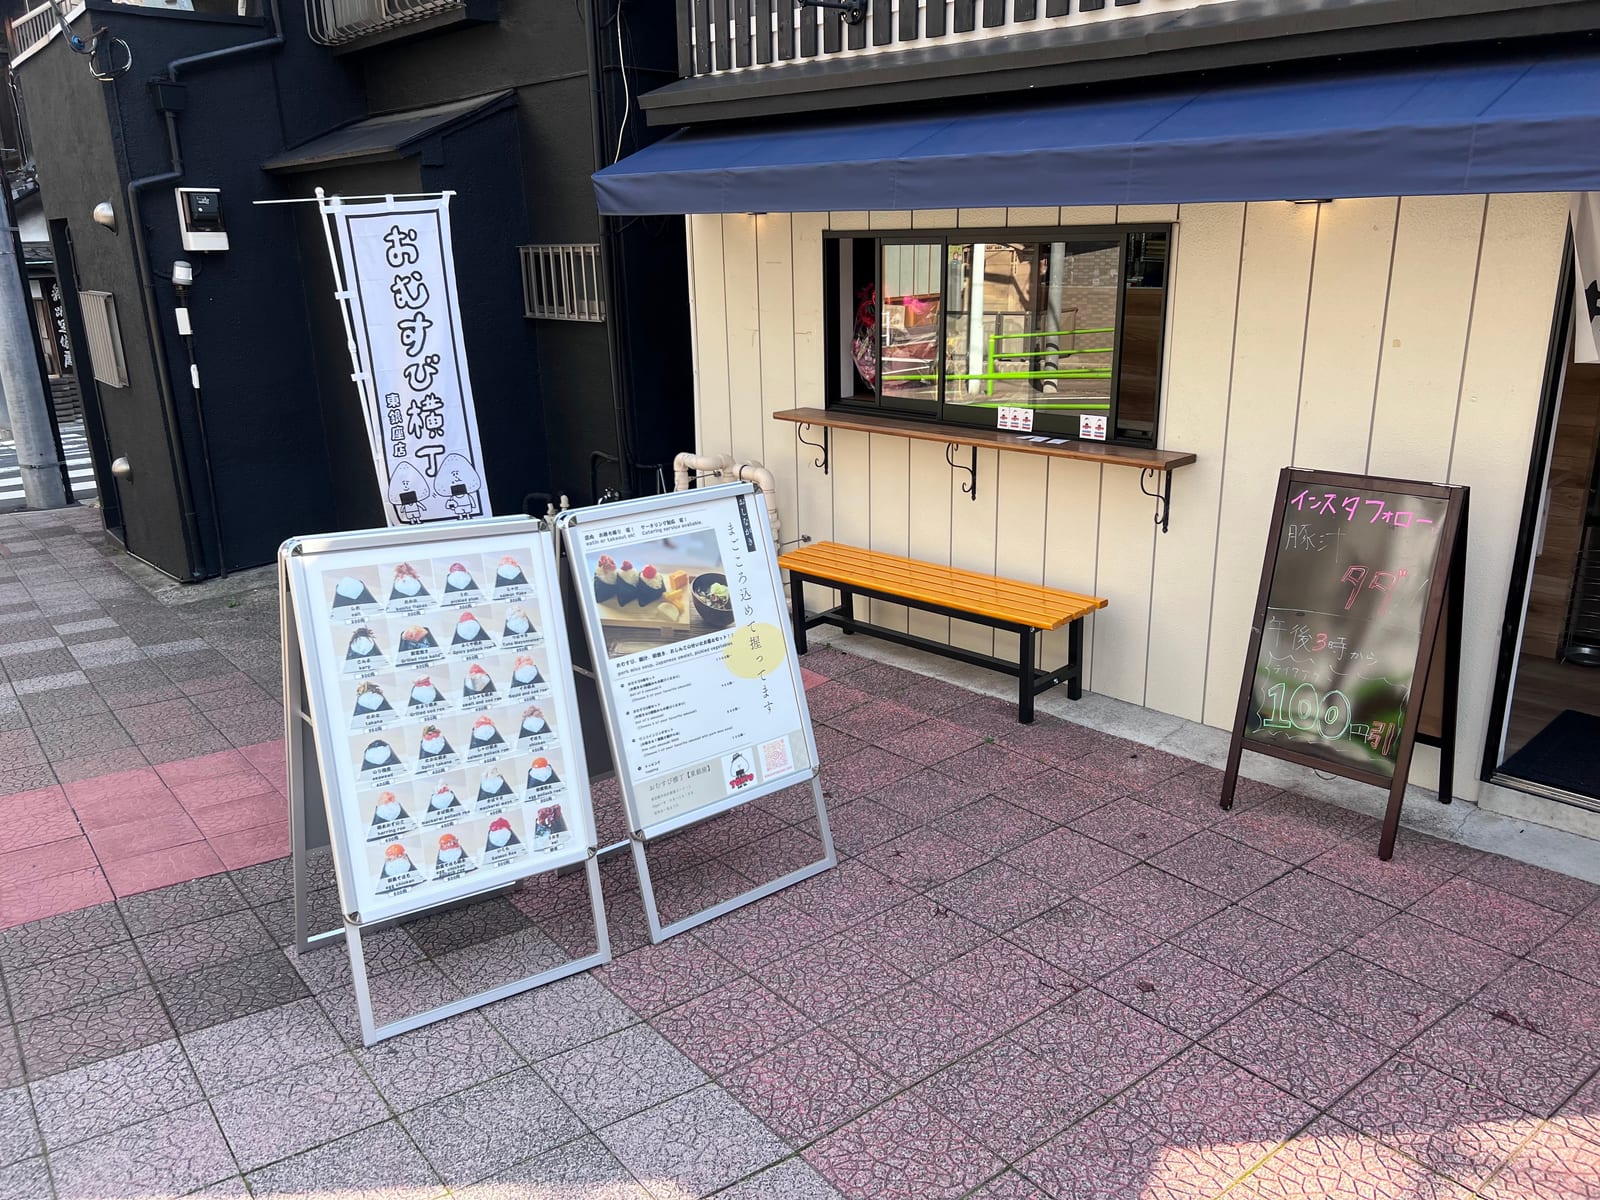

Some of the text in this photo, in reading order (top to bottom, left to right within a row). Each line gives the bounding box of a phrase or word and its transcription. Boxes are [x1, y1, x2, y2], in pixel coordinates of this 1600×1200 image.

[384, 224, 445, 478] おむすび横丁
[385, 392, 407, 458] 東銀座店
[641, 527, 662, 536] Catering
[1290, 489, 1433, 529] インスタフォロー
[1285, 523, 1348, 564] 豚汁
[1341, 565, 1408, 615] タダ
[727, 521, 774, 714] まごころ込めて握ってます
[1266, 616, 1378, 666] 午後3時から
[655, 656, 676, 666] Japanese
[1263, 682, 1395, 756] 100円引
